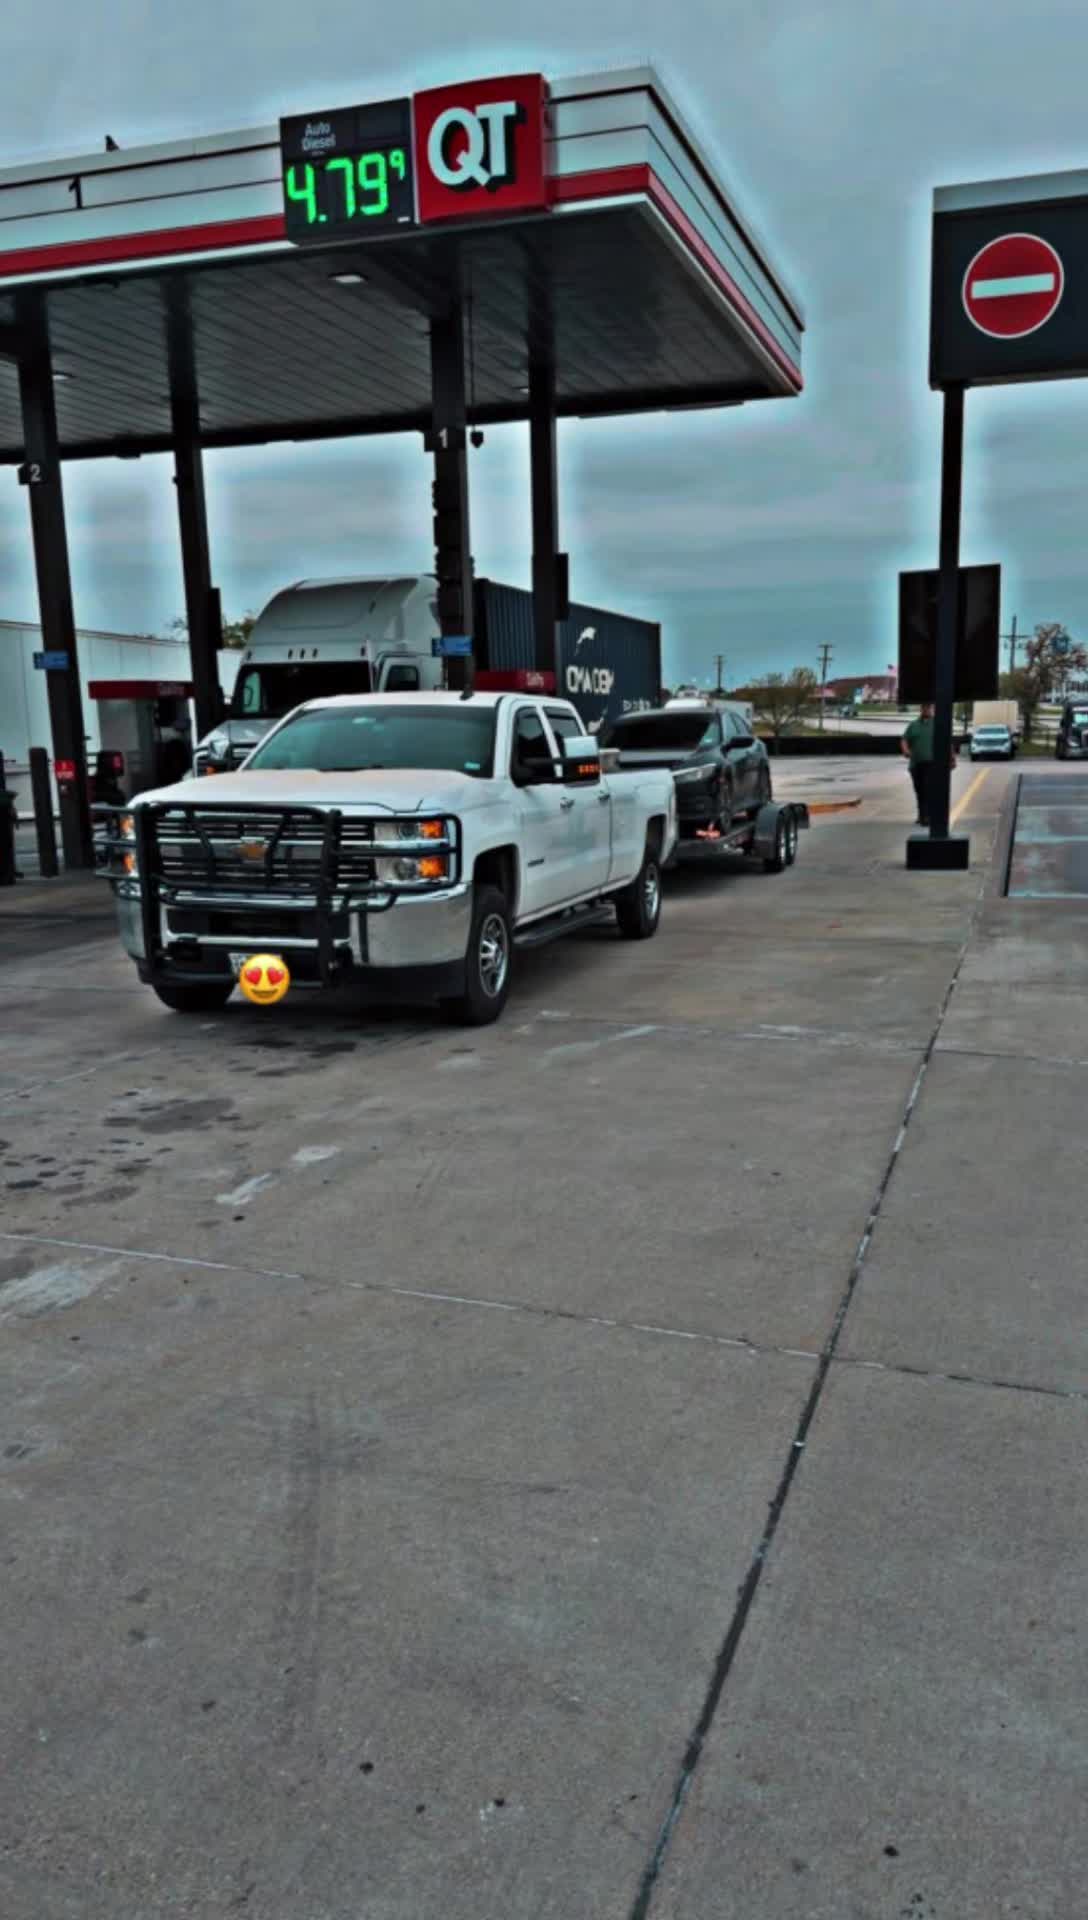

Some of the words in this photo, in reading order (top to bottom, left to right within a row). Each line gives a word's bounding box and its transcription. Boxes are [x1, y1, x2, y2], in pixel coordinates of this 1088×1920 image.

[302, 133, 337, 151] Diesel
[427, 101, 517, 187] QT
[69, 175, 83, 209] 1
[438, 428, 448, 448] 1
[30, 463, 41, 482] 2
